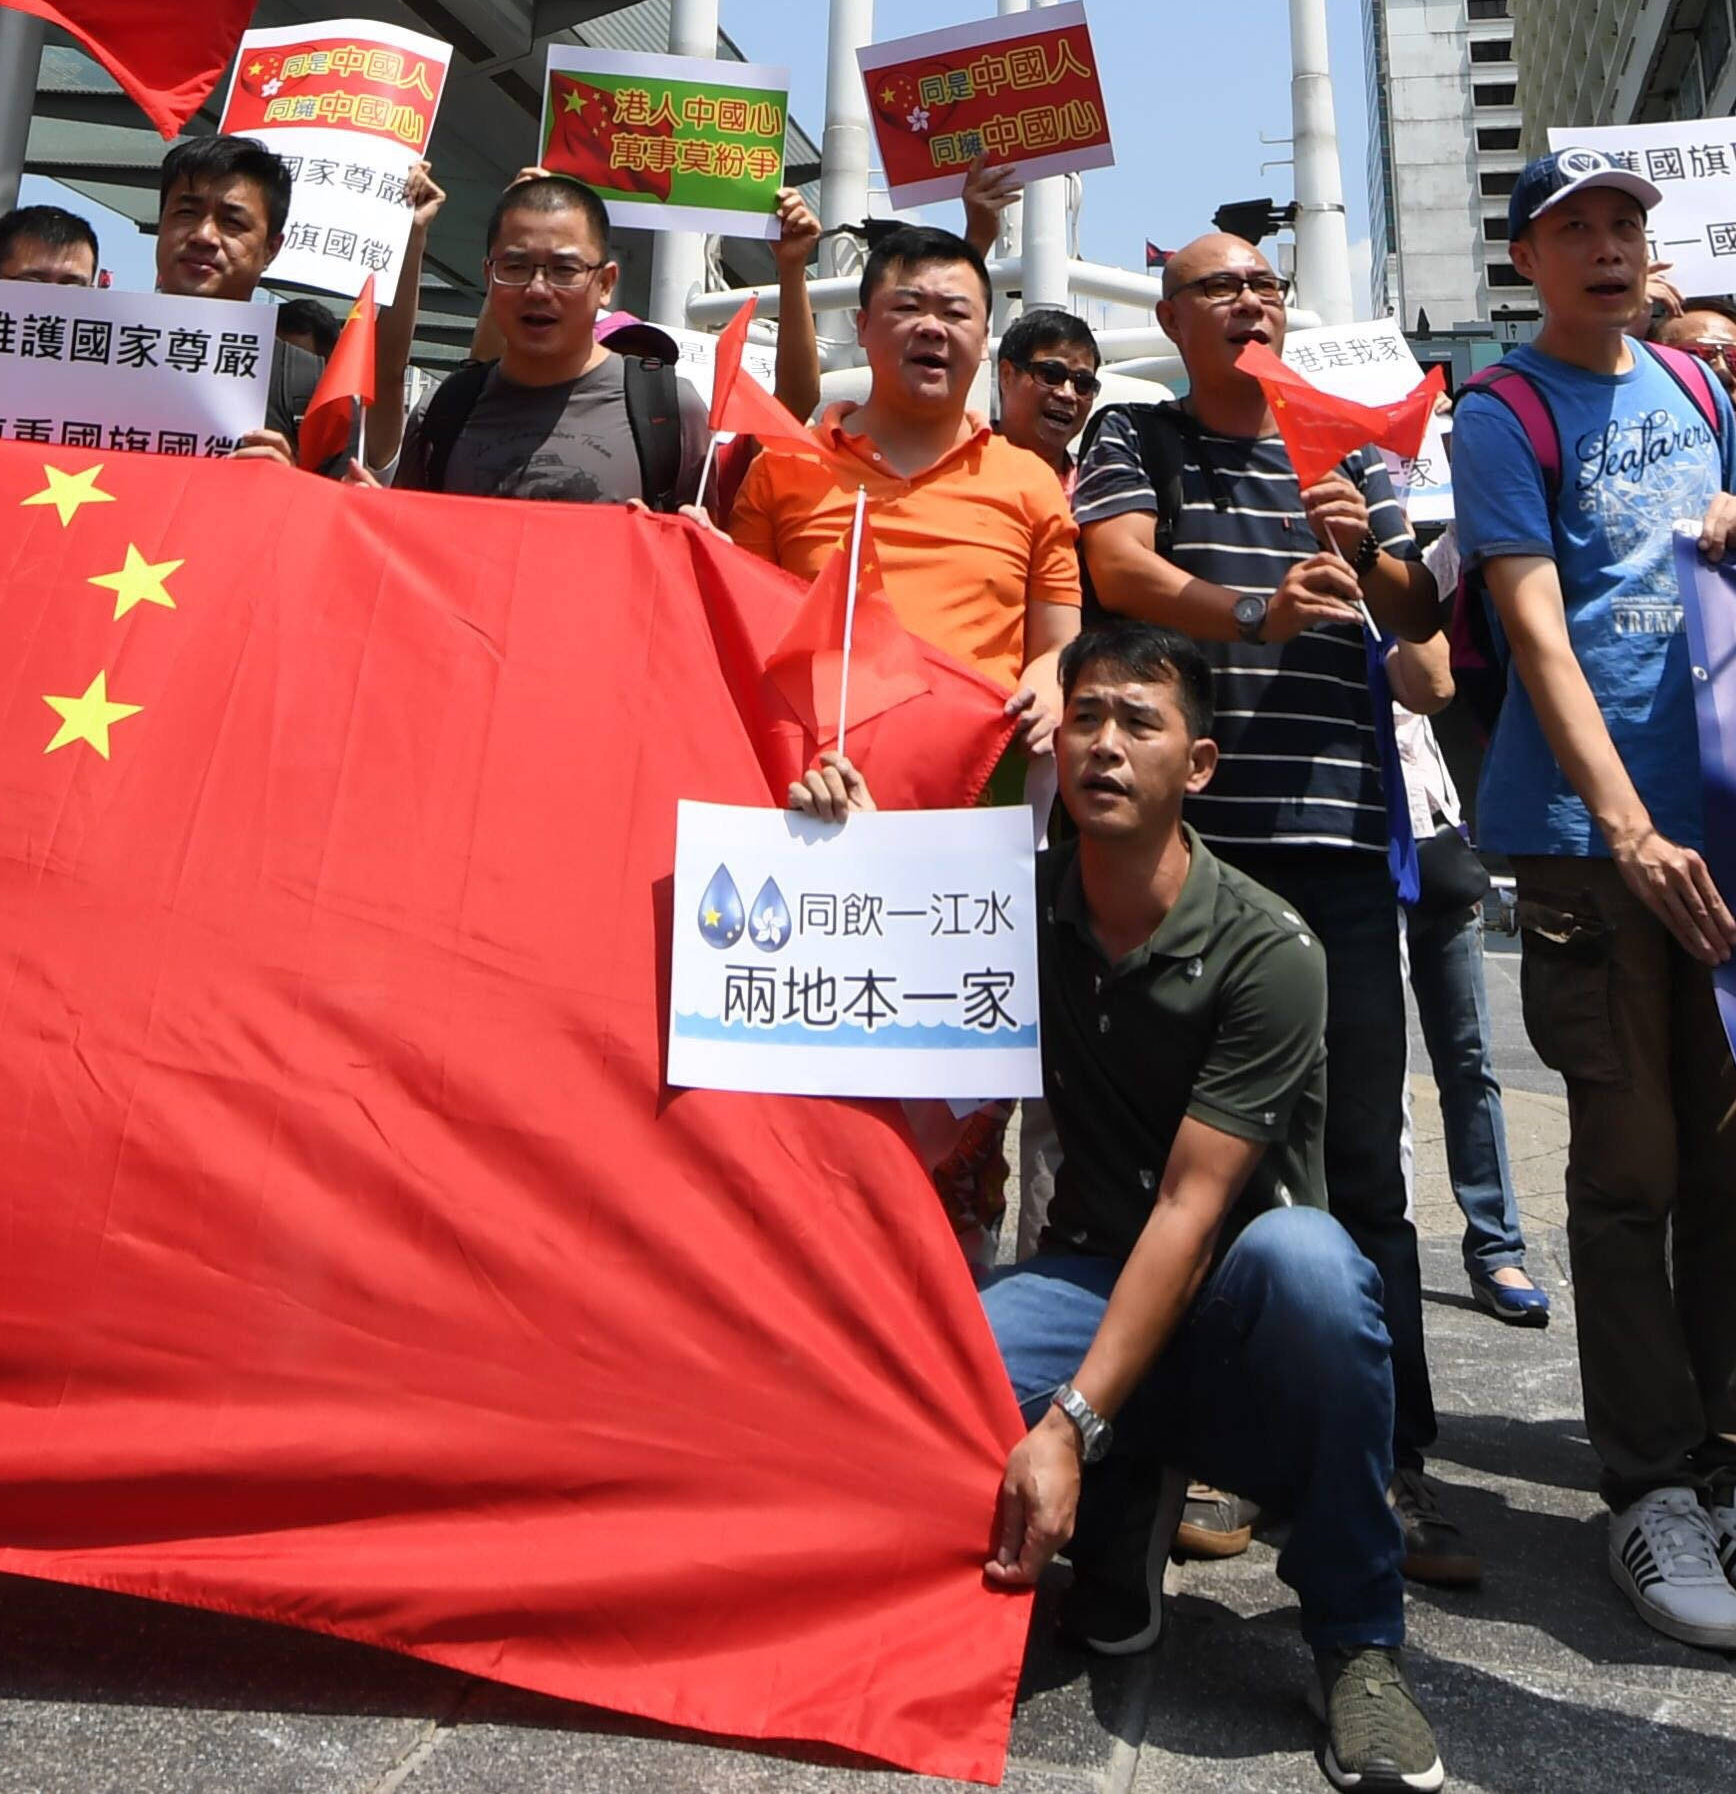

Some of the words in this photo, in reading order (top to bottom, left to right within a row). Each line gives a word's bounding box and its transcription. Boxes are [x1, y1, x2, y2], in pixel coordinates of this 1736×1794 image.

[280, 46, 434, 101] 同是中國人
[918, 38, 1091, 109] 同是中國人
[264, 90, 425, 144] 同擁中國心
[611, 87, 782, 137] 港人中國心
[928, 98, 1103, 168] 同擁中國心
[609, 132, 780, 183] 萬事莫紛爭
[1286, 336, 1407, 373] 港是我家
[1576, 409, 1712, 491] Seafarers
[799, 890, 1015, 936] 同飲一江水
[724, 965, 1019, 1029] 兩地本一家
